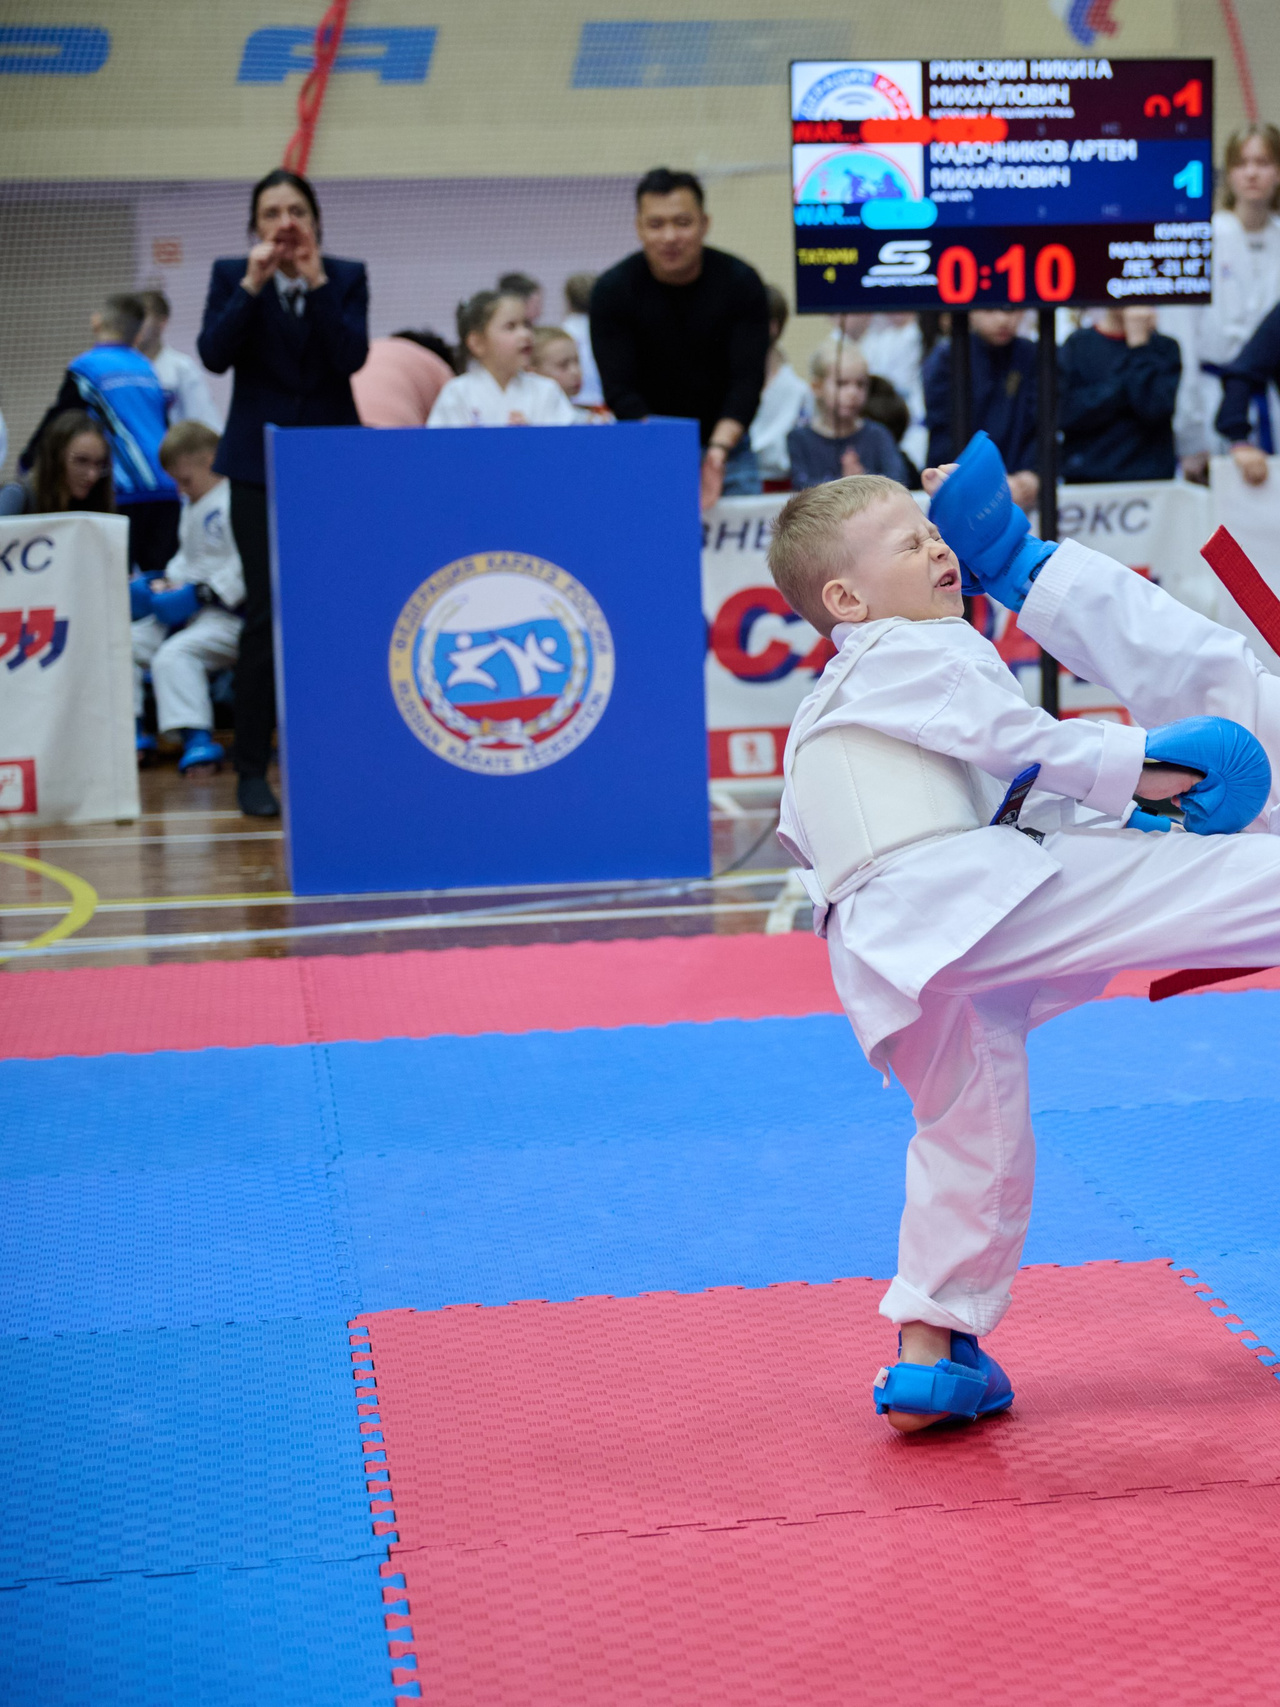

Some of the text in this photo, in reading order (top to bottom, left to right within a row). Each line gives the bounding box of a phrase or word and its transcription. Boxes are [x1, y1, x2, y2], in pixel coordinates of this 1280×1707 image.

[1173, 79, 1203, 117] 1
[1070, 139, 1137, 162] АРТЕМ
[1173, 160, 1204, 198] 1
[937, 243, 1076, 304] 0:10
